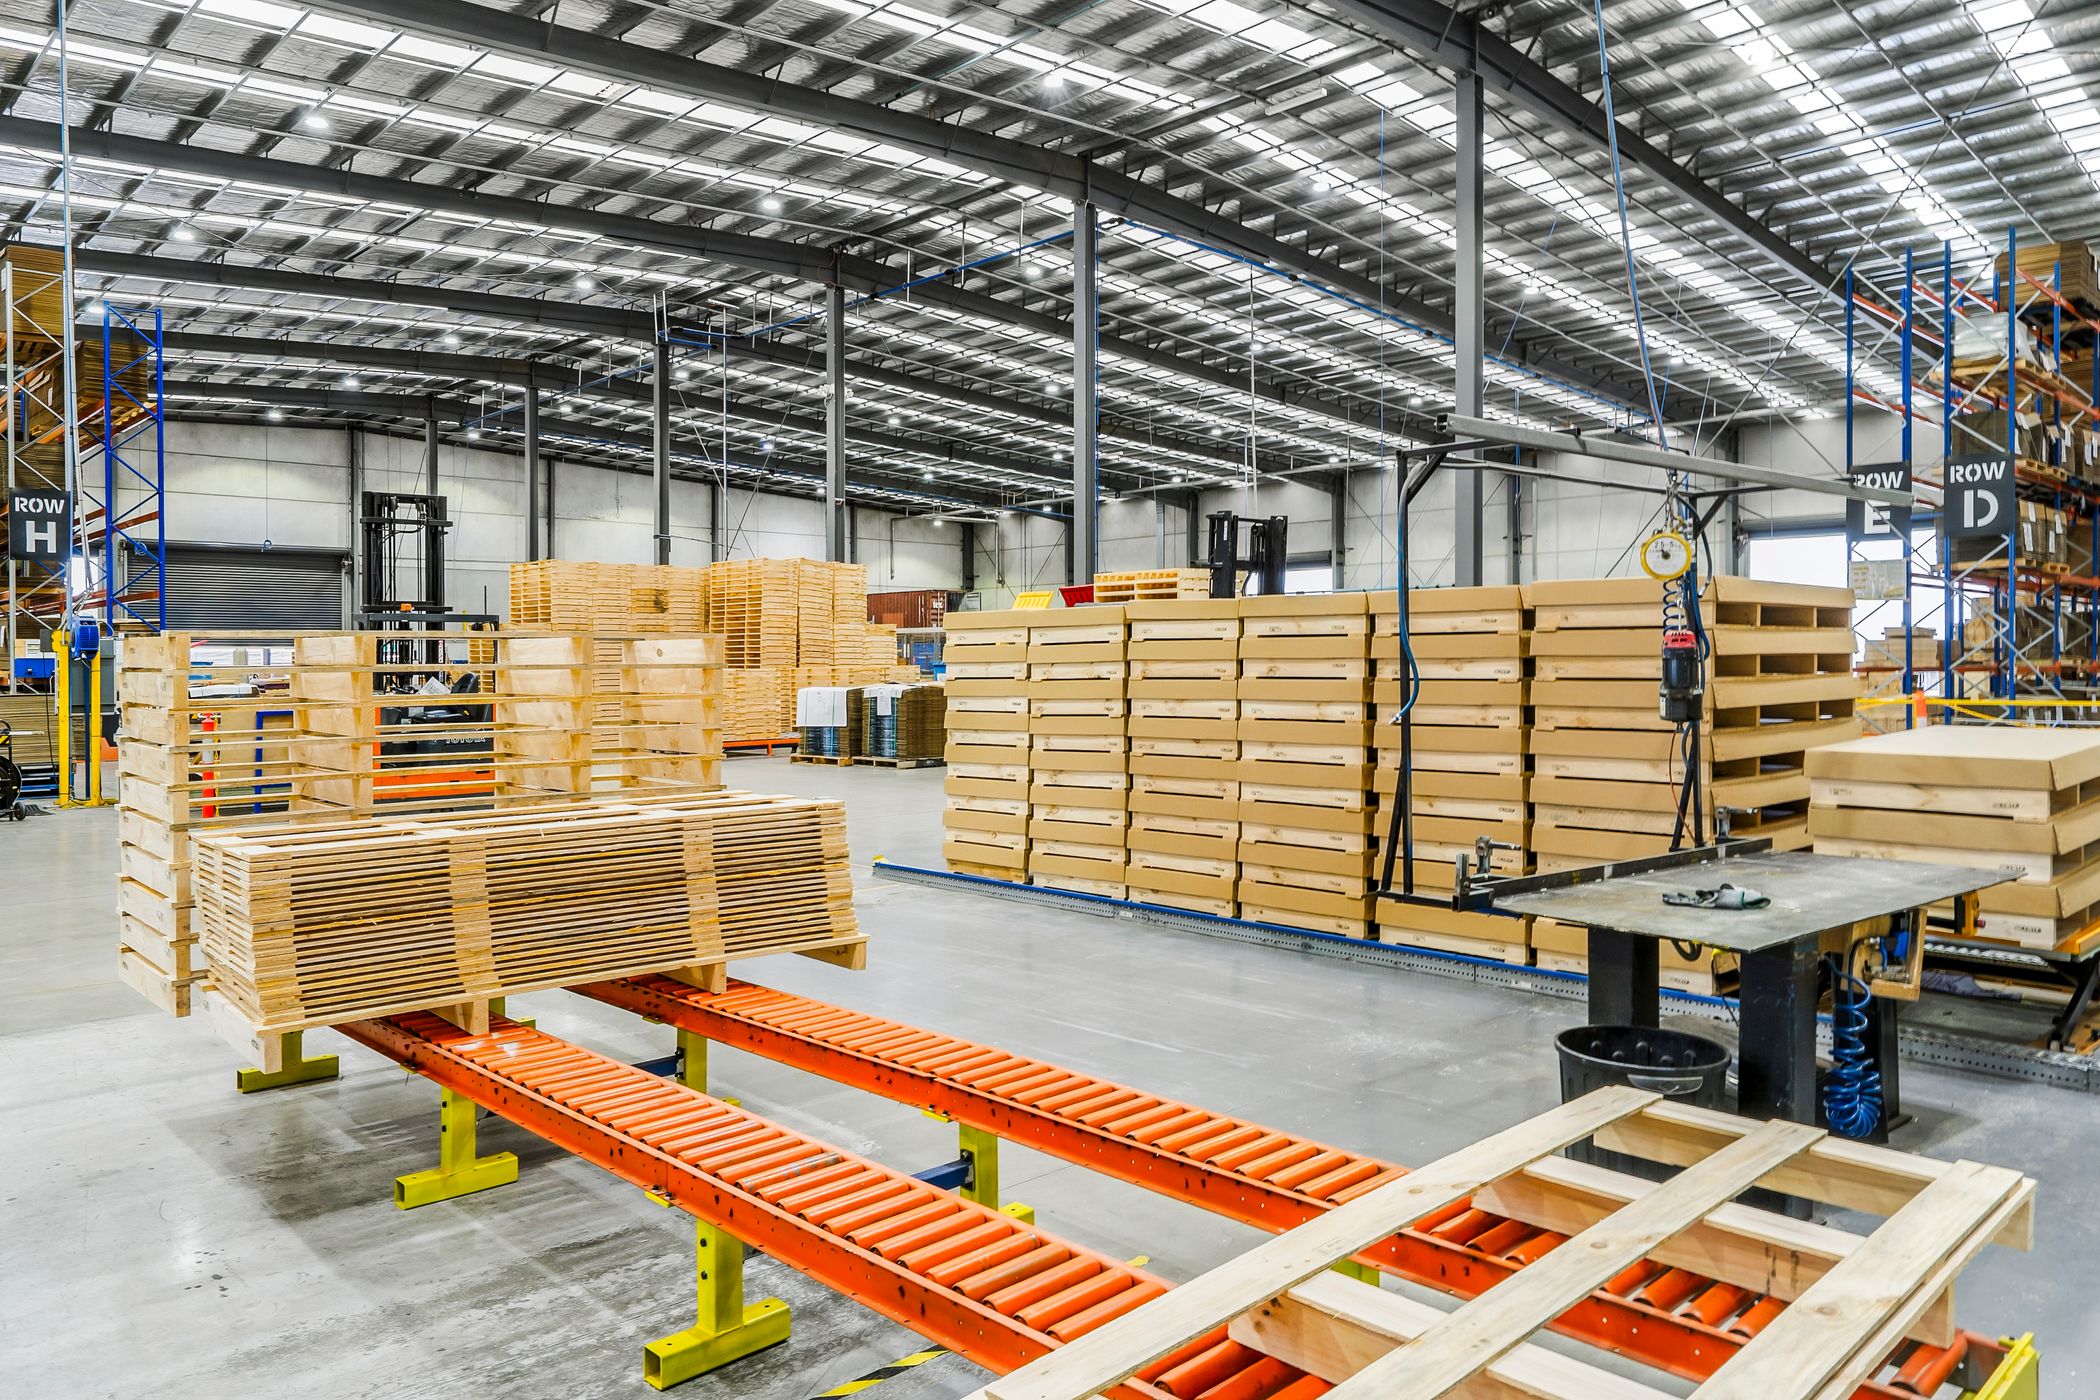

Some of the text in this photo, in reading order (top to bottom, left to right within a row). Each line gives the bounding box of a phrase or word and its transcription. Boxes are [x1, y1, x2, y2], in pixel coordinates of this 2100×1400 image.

[1853, 471, 1904, 489] ROW
[1949, 461, 2006, 484] ROW
[14, 497, 65, 514] ROW
[1864, 499, 1891, 534] E
[1963, 489, 1999, 528] D
[25, 520, 57, 553] H
